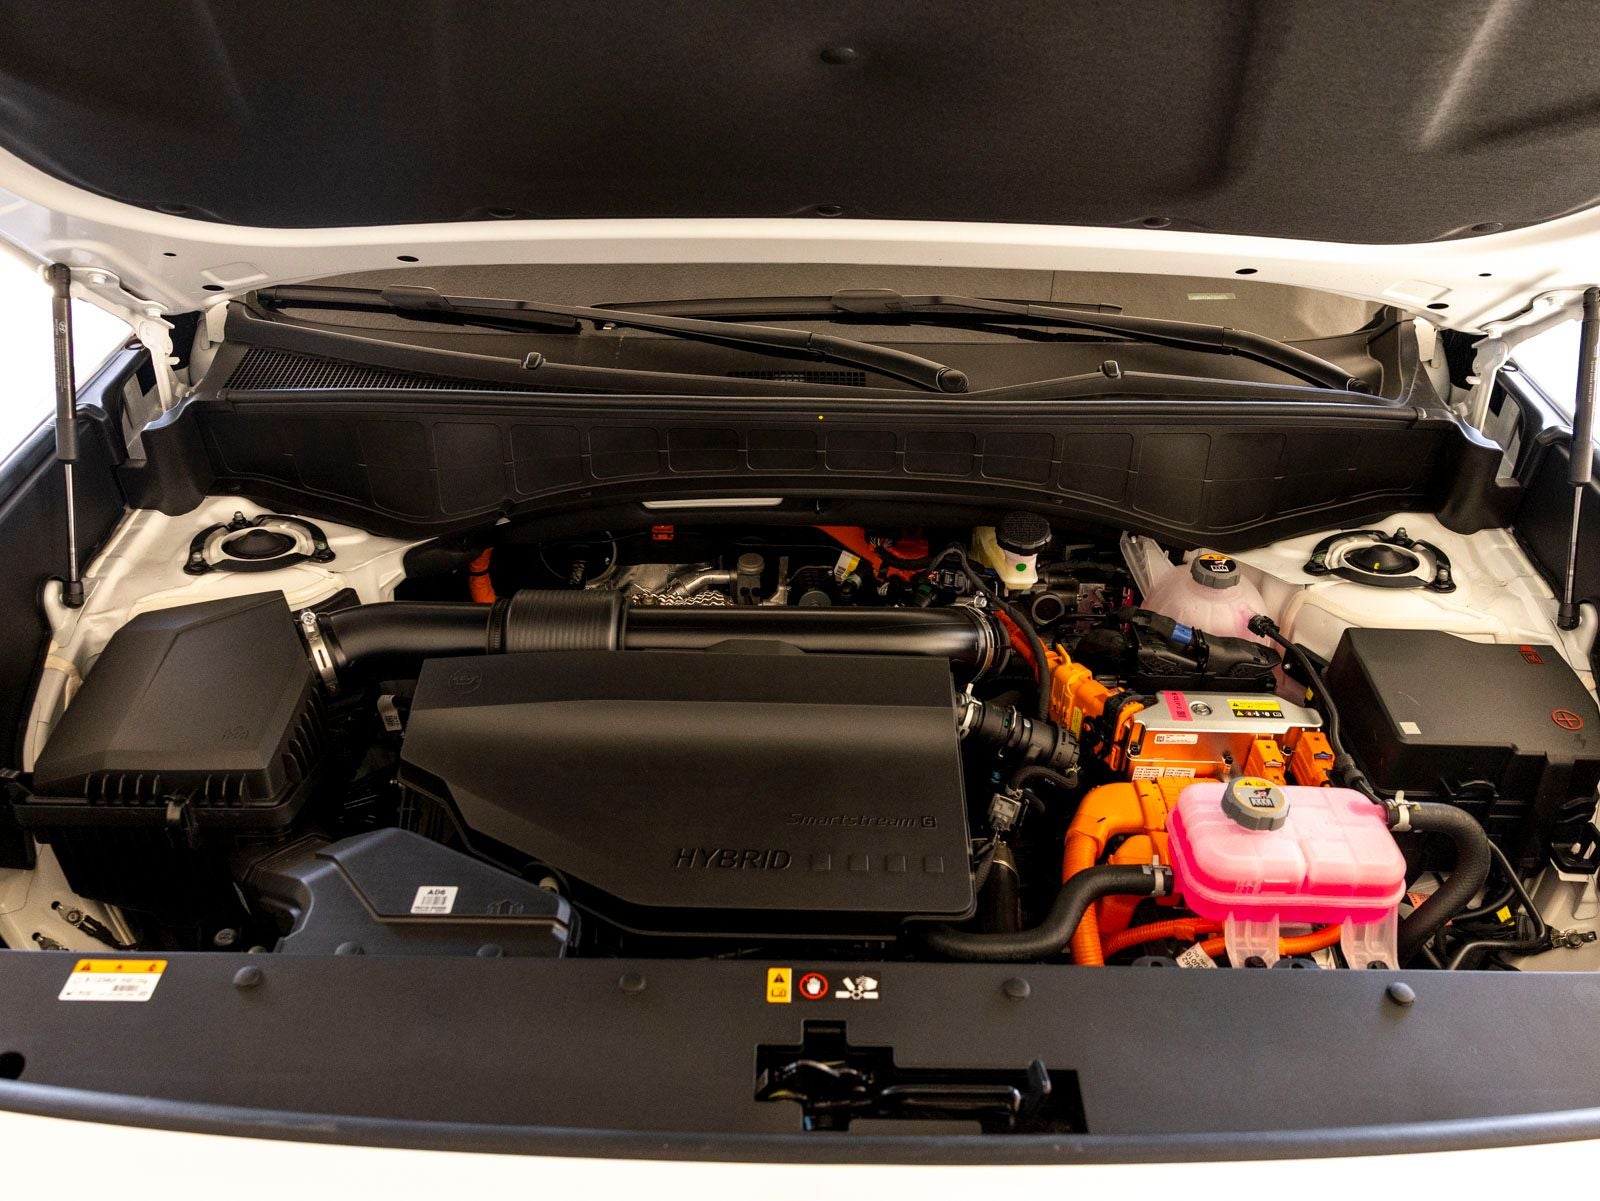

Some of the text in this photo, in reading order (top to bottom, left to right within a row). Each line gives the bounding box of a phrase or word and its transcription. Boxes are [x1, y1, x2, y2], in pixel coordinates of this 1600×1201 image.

[786, 813, 937, 829] Smartstream G
[675, 848, 793, 870] HYBRID
